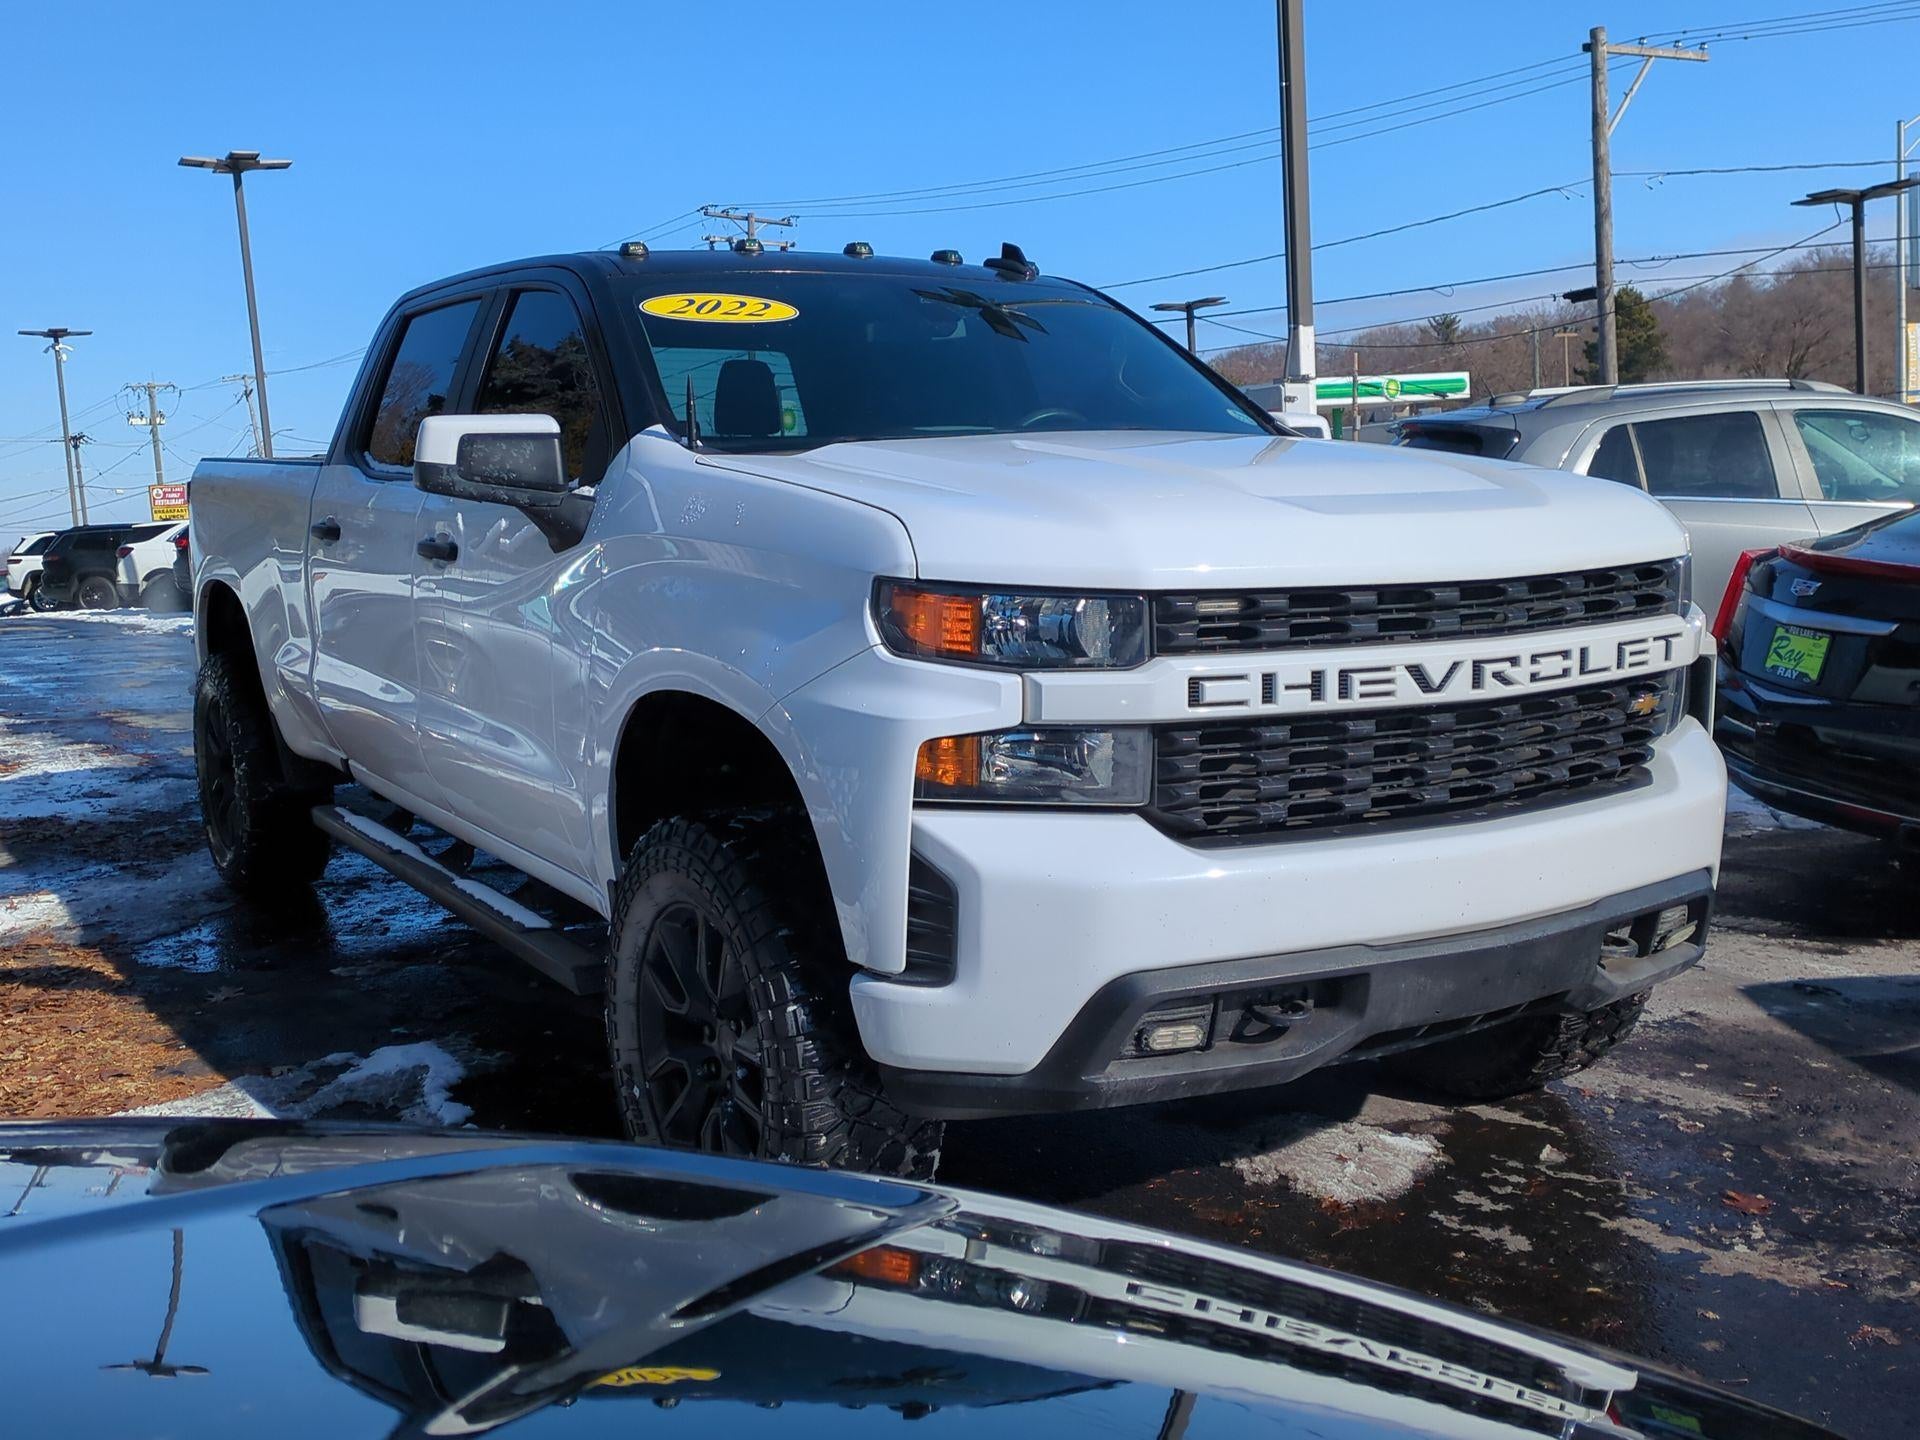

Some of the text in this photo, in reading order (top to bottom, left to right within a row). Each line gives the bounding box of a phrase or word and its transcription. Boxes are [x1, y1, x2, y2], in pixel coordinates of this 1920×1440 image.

[667, 298, 772, 317] 2022
[1773, 635, 1806, 668] Ray
[1187, 631, 1684, 709] CHEVROLET
[1776, 666, 1799, 680] RAY
